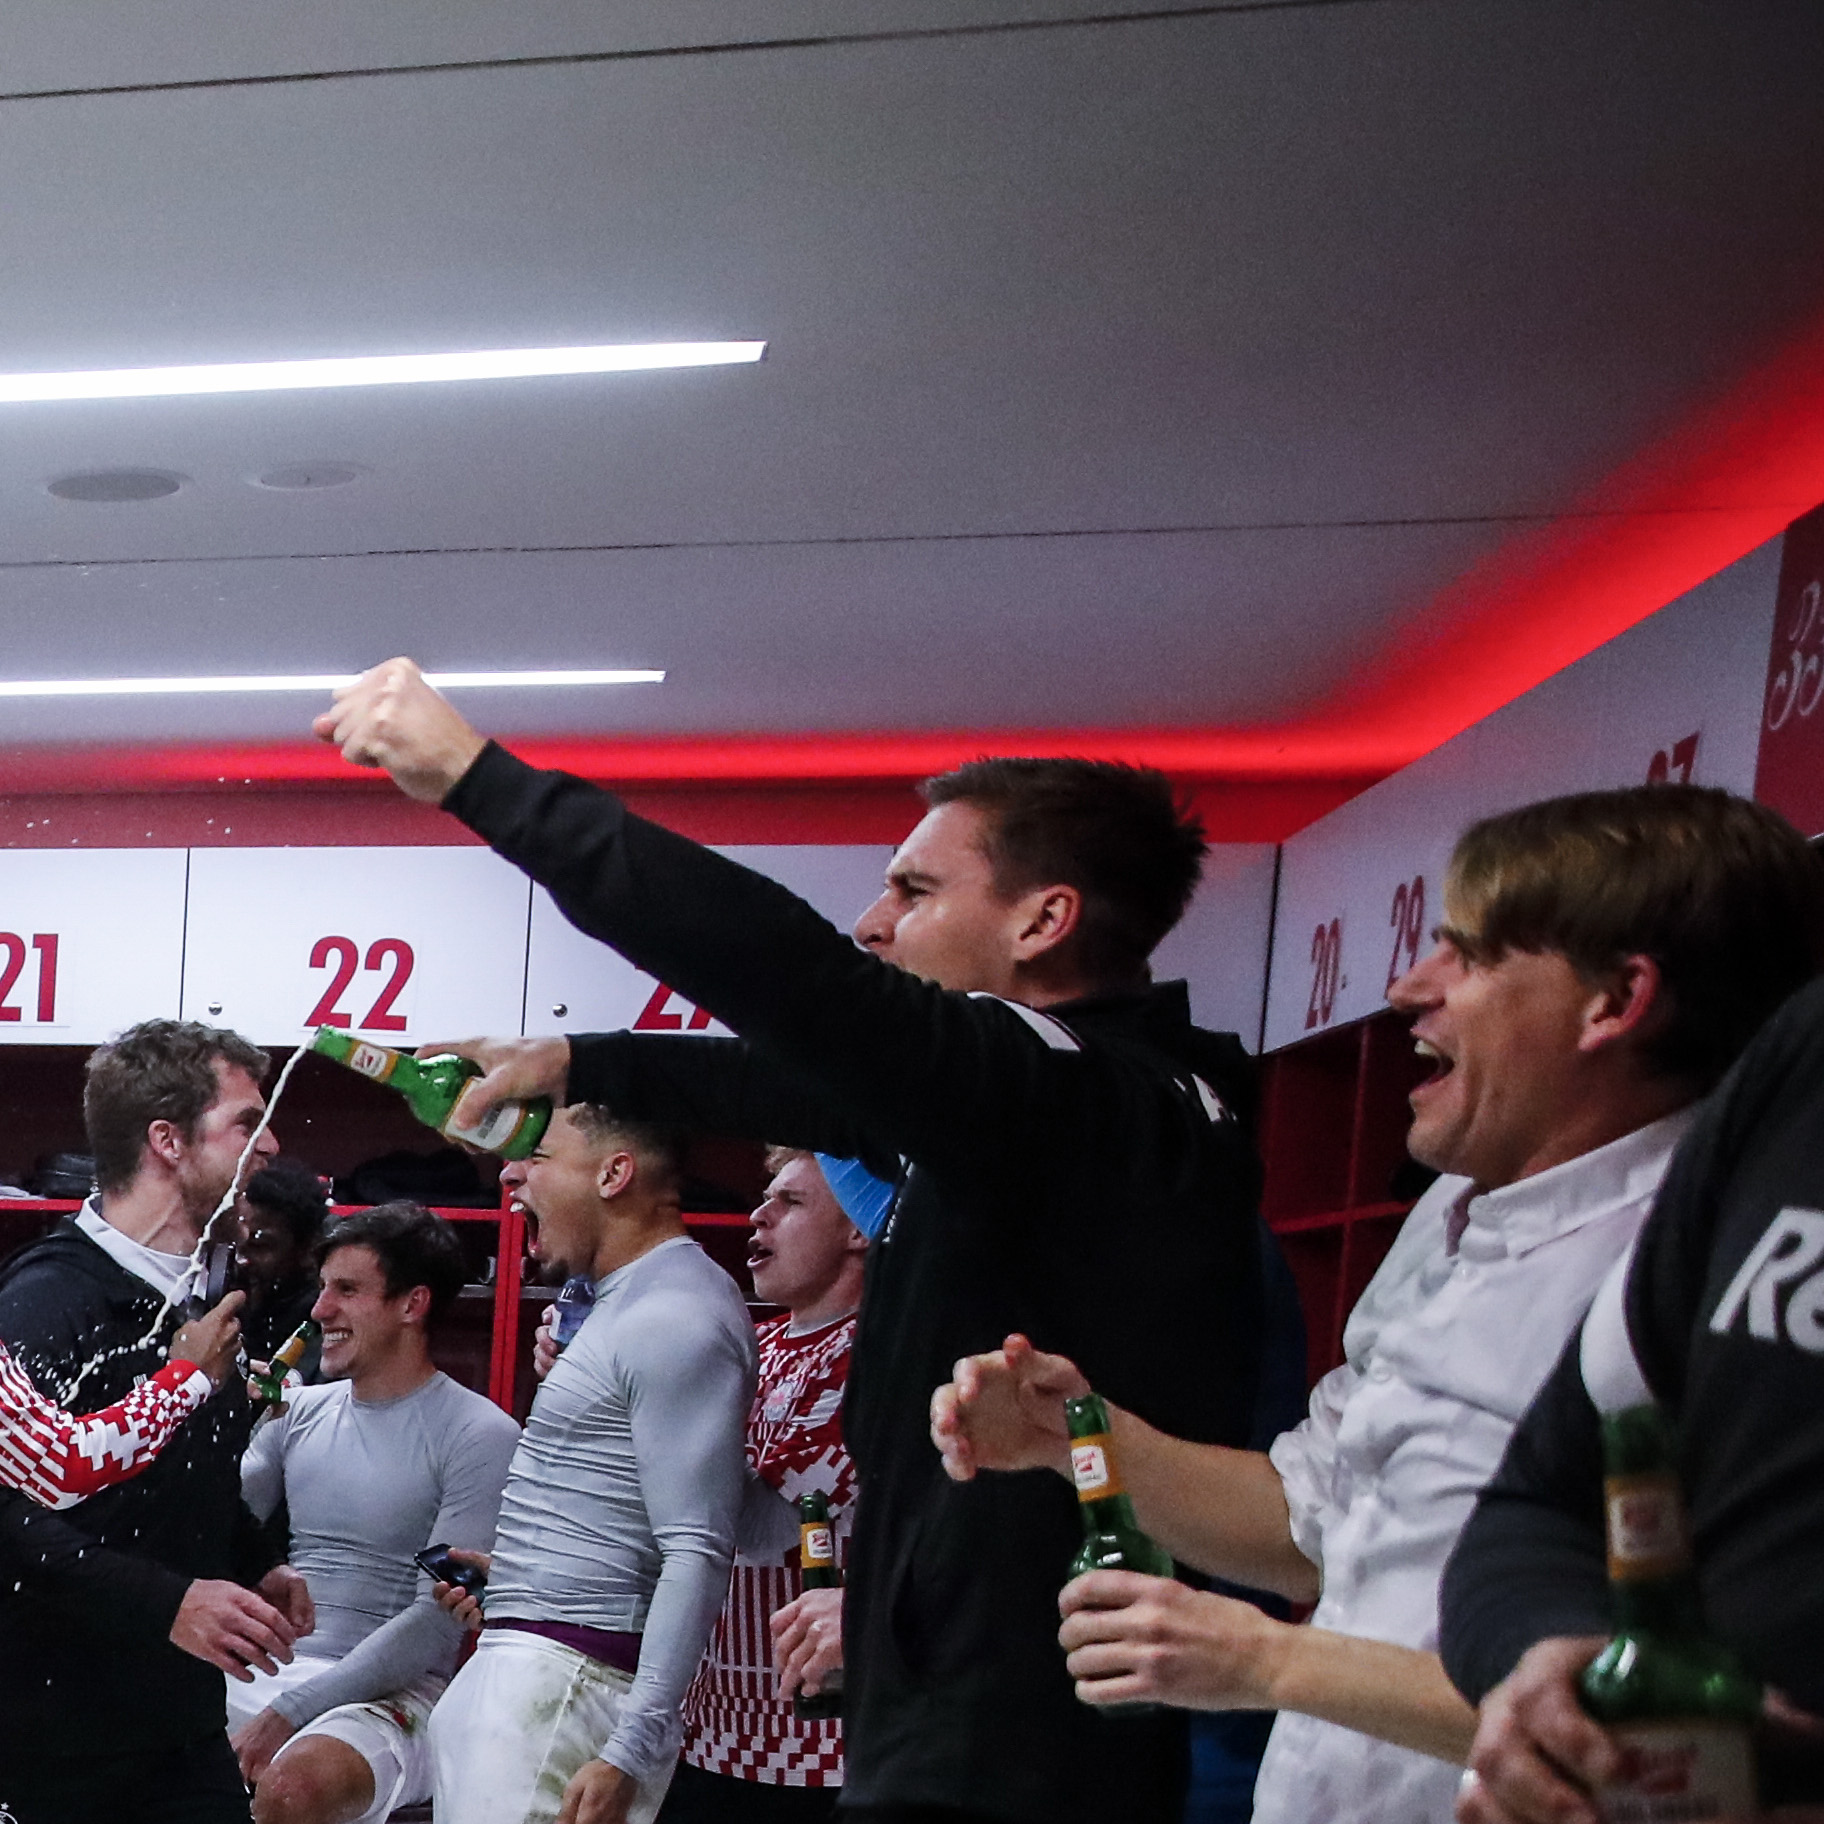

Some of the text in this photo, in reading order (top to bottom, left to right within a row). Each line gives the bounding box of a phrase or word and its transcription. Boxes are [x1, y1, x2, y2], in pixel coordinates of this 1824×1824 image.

[303, 935, 415, 1032] 22
[1304, 917, 1342, 1030] 20
[1383, 874, 1426, 1000] 29
